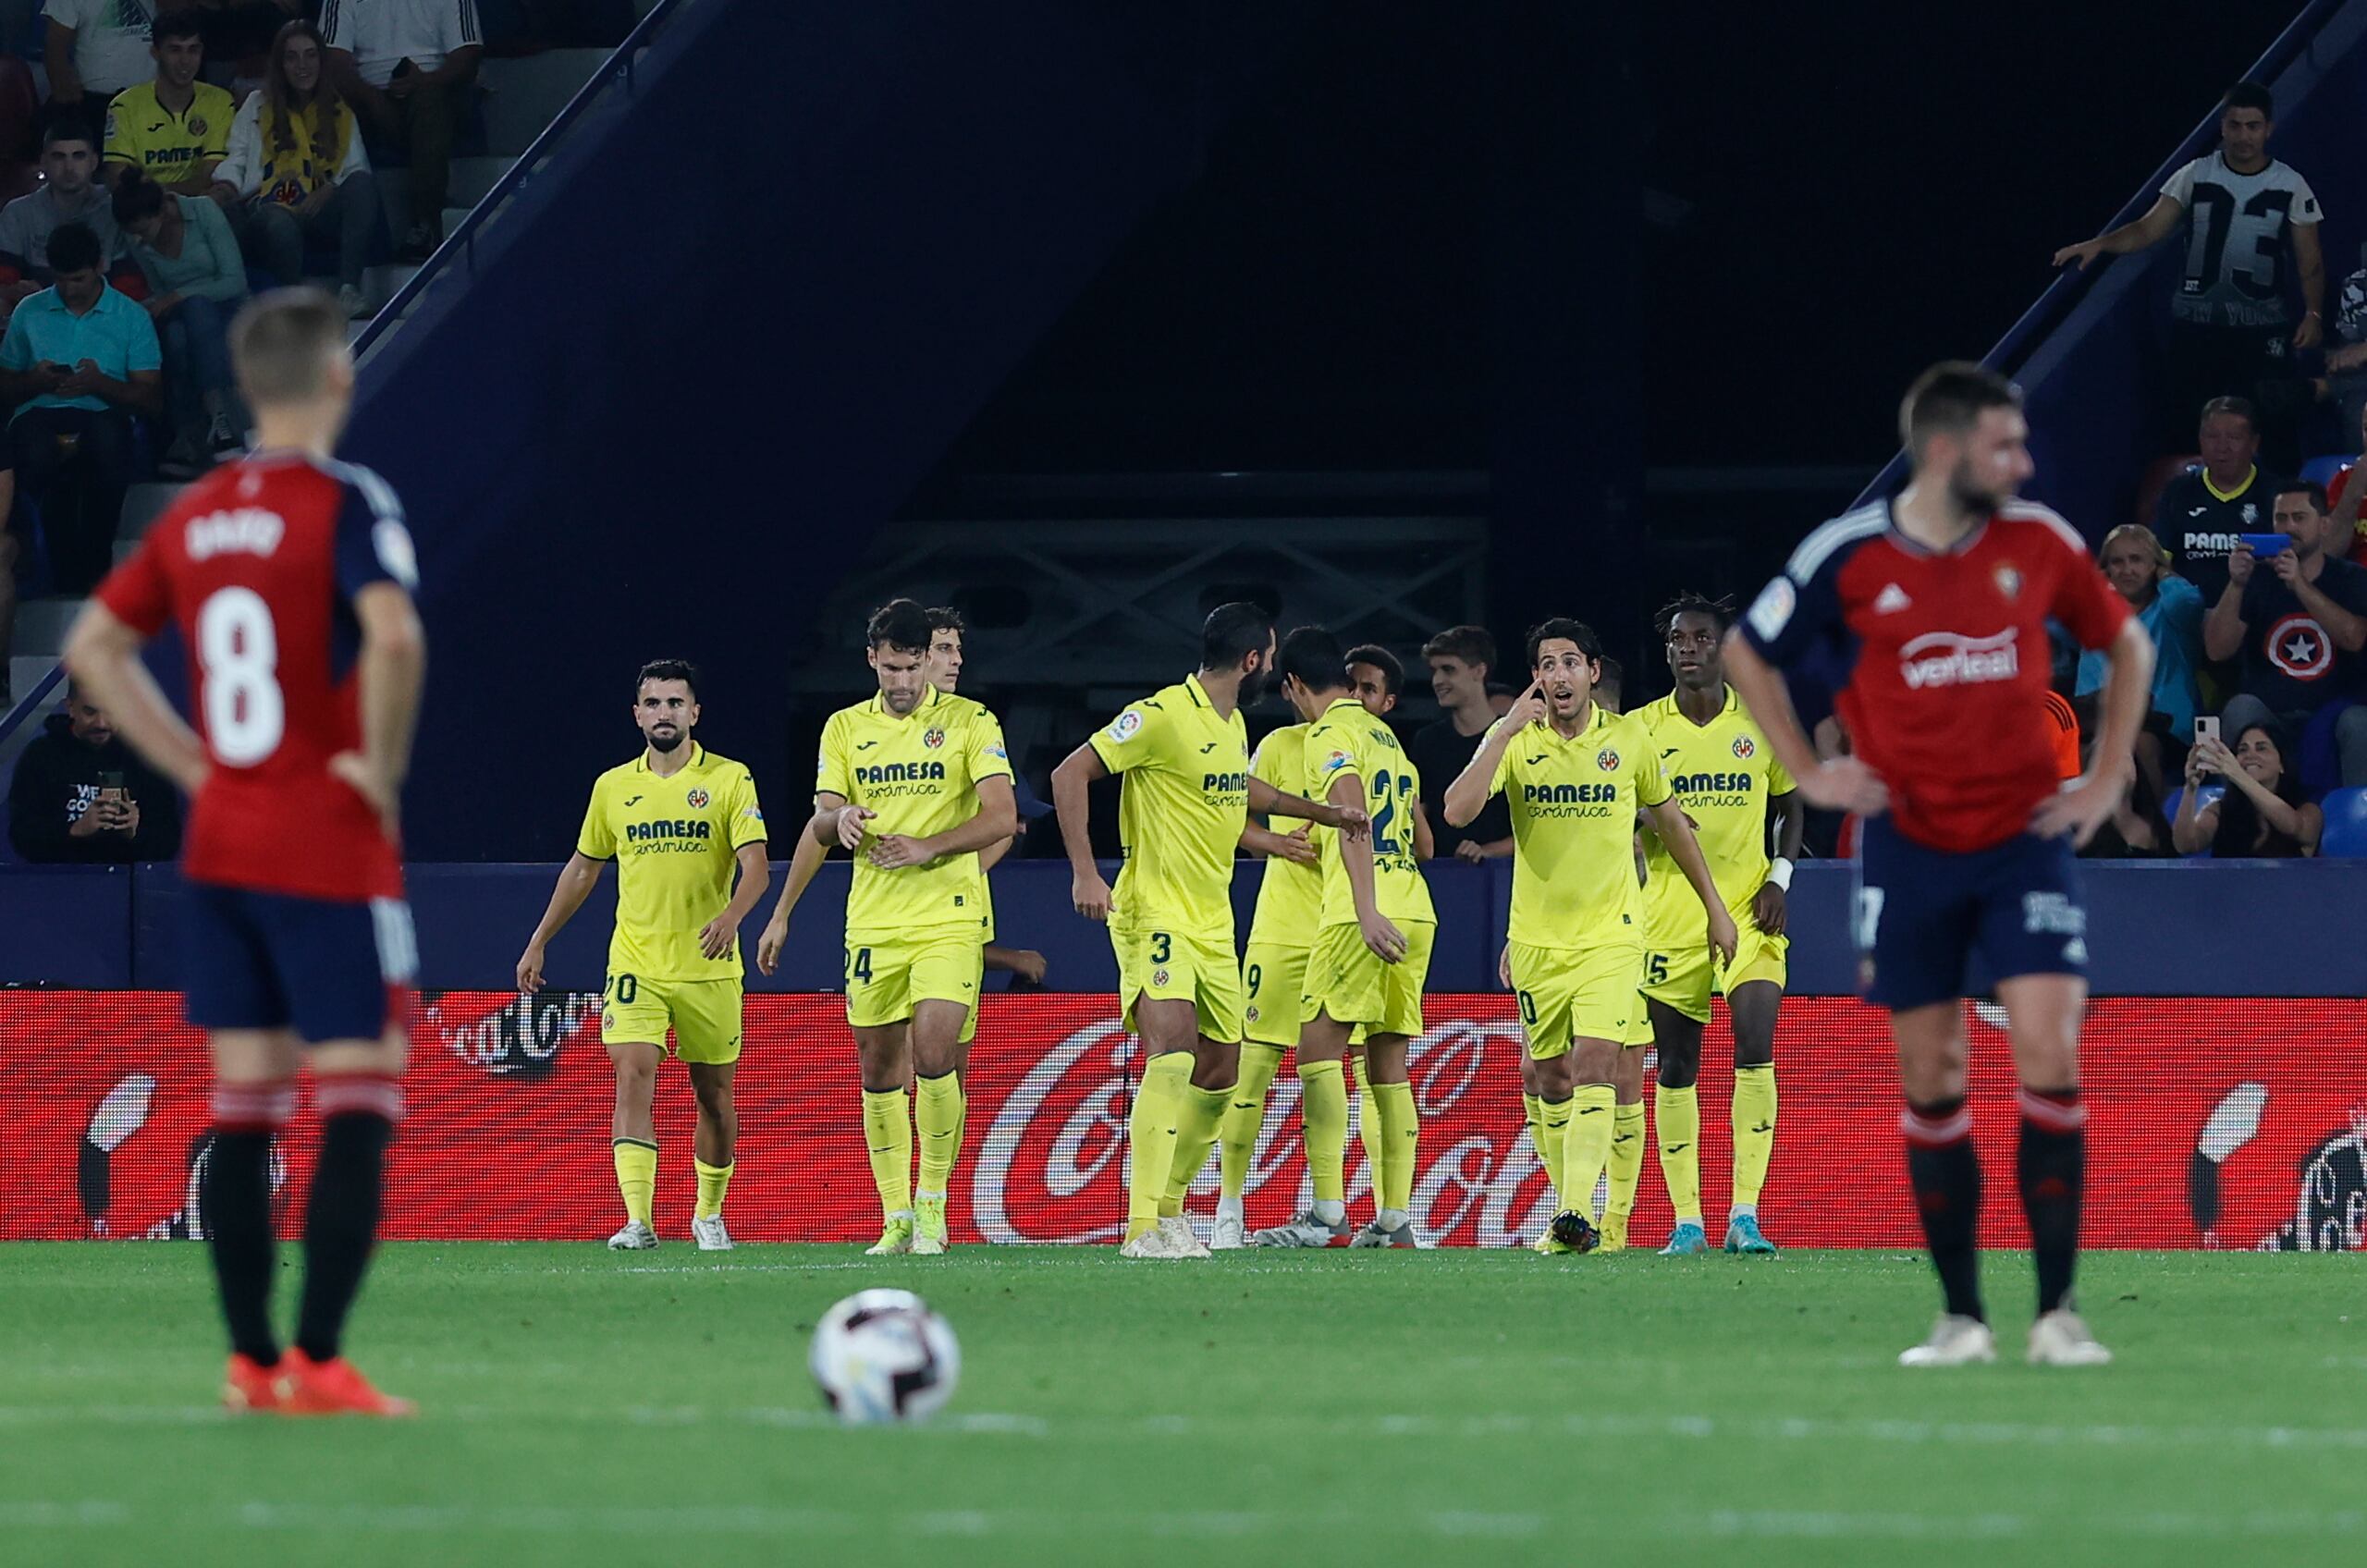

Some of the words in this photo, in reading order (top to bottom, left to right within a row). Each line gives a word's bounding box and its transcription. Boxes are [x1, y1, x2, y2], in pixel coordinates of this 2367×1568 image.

[196, 585, 286, 768] 8
[855, 761, 945, 786] PAMESA
[1669, 773, 1752, 794] AMESA
[1524, 784, 1616, 803] PAMESA
[1527, 804, 1613, 818] cerámica
[626, 819, 710, 842] PAMESA
[1150, 932, 1171, 964] 3
